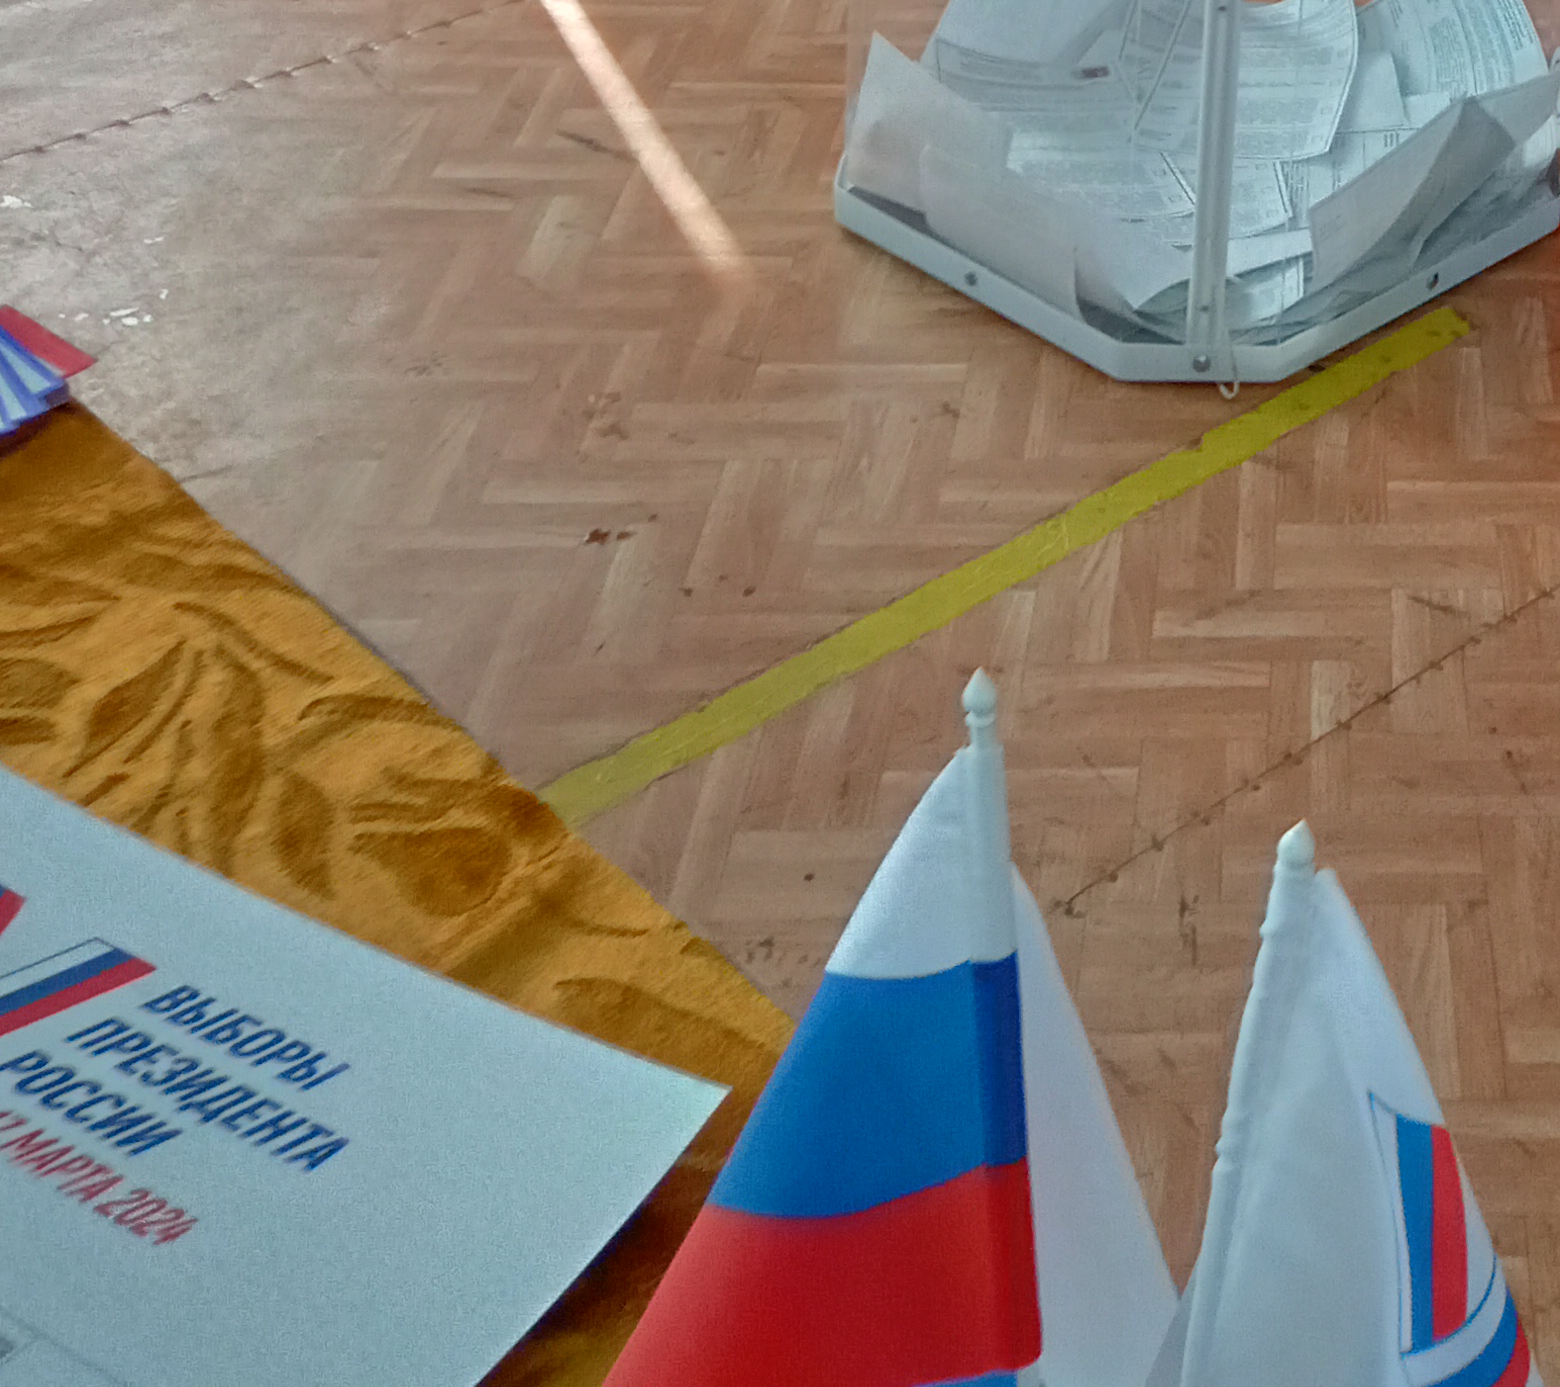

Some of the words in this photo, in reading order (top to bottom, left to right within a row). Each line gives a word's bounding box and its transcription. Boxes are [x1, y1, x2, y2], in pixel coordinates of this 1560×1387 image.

[65, 1015, 351, 1172] ПРЕЗИДЕНТА
[138, 983, 352, 1092] ВЫБОРЫ
[0, 1049, 187, 1158] РОССИИ
[0, 1128, 126, 1204] МАРТА
[93, 1188, 199, 1246] 2024
